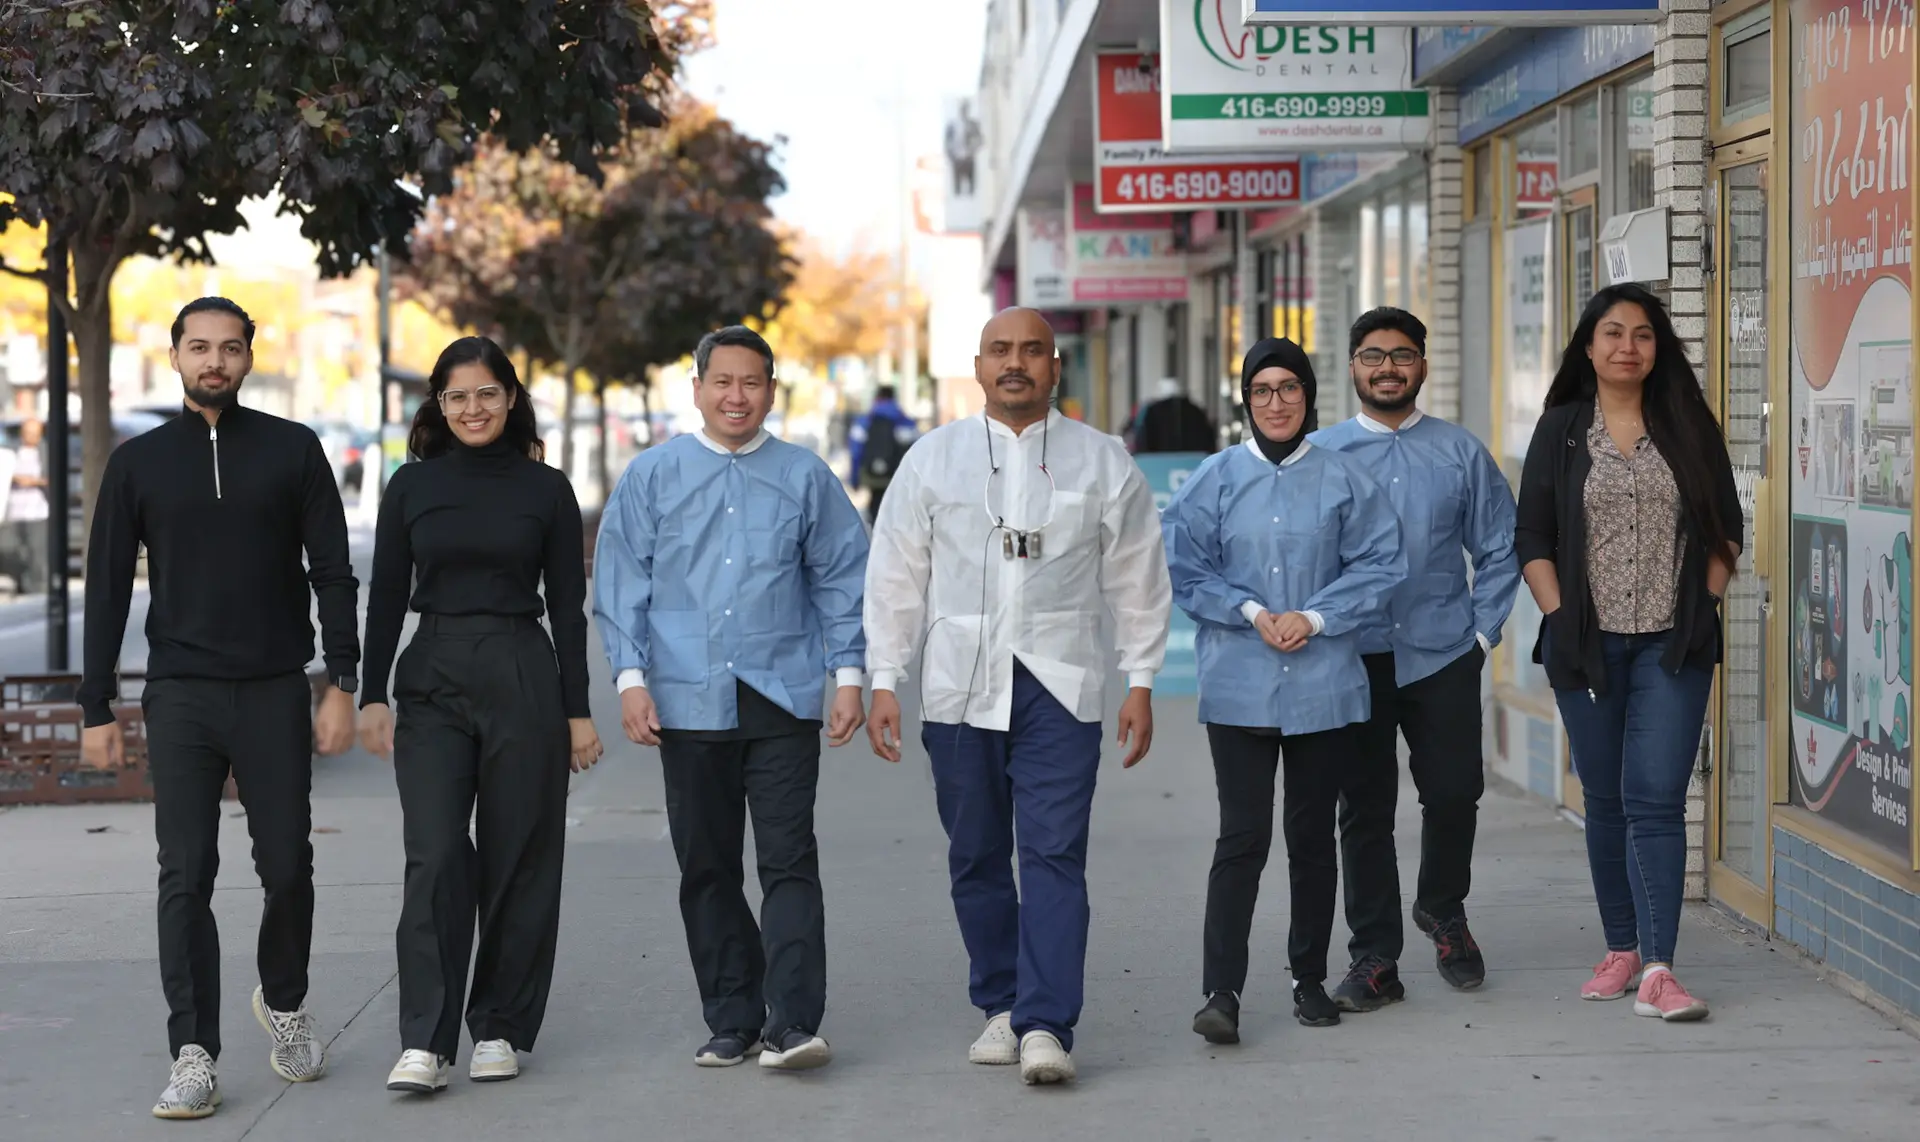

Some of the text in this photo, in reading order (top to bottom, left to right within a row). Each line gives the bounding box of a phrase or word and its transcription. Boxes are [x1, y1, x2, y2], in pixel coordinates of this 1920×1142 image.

[1256, 26, 1376, 54] DESH
[1256, 63, 1379, 77] DENTAL
[1220, 96, 1386, 118] 416-690-9999
[1258, 123, 1383, 137] www.deshdental.ca
[1103, 149, 1145, 161] Family
[1116, 169, 1293, 200] 416-690-9000
[1856, 741, 1882, 782] Design
[1884, 752, 1890, 780] &
[1872, 784, 1907, 827] Services
